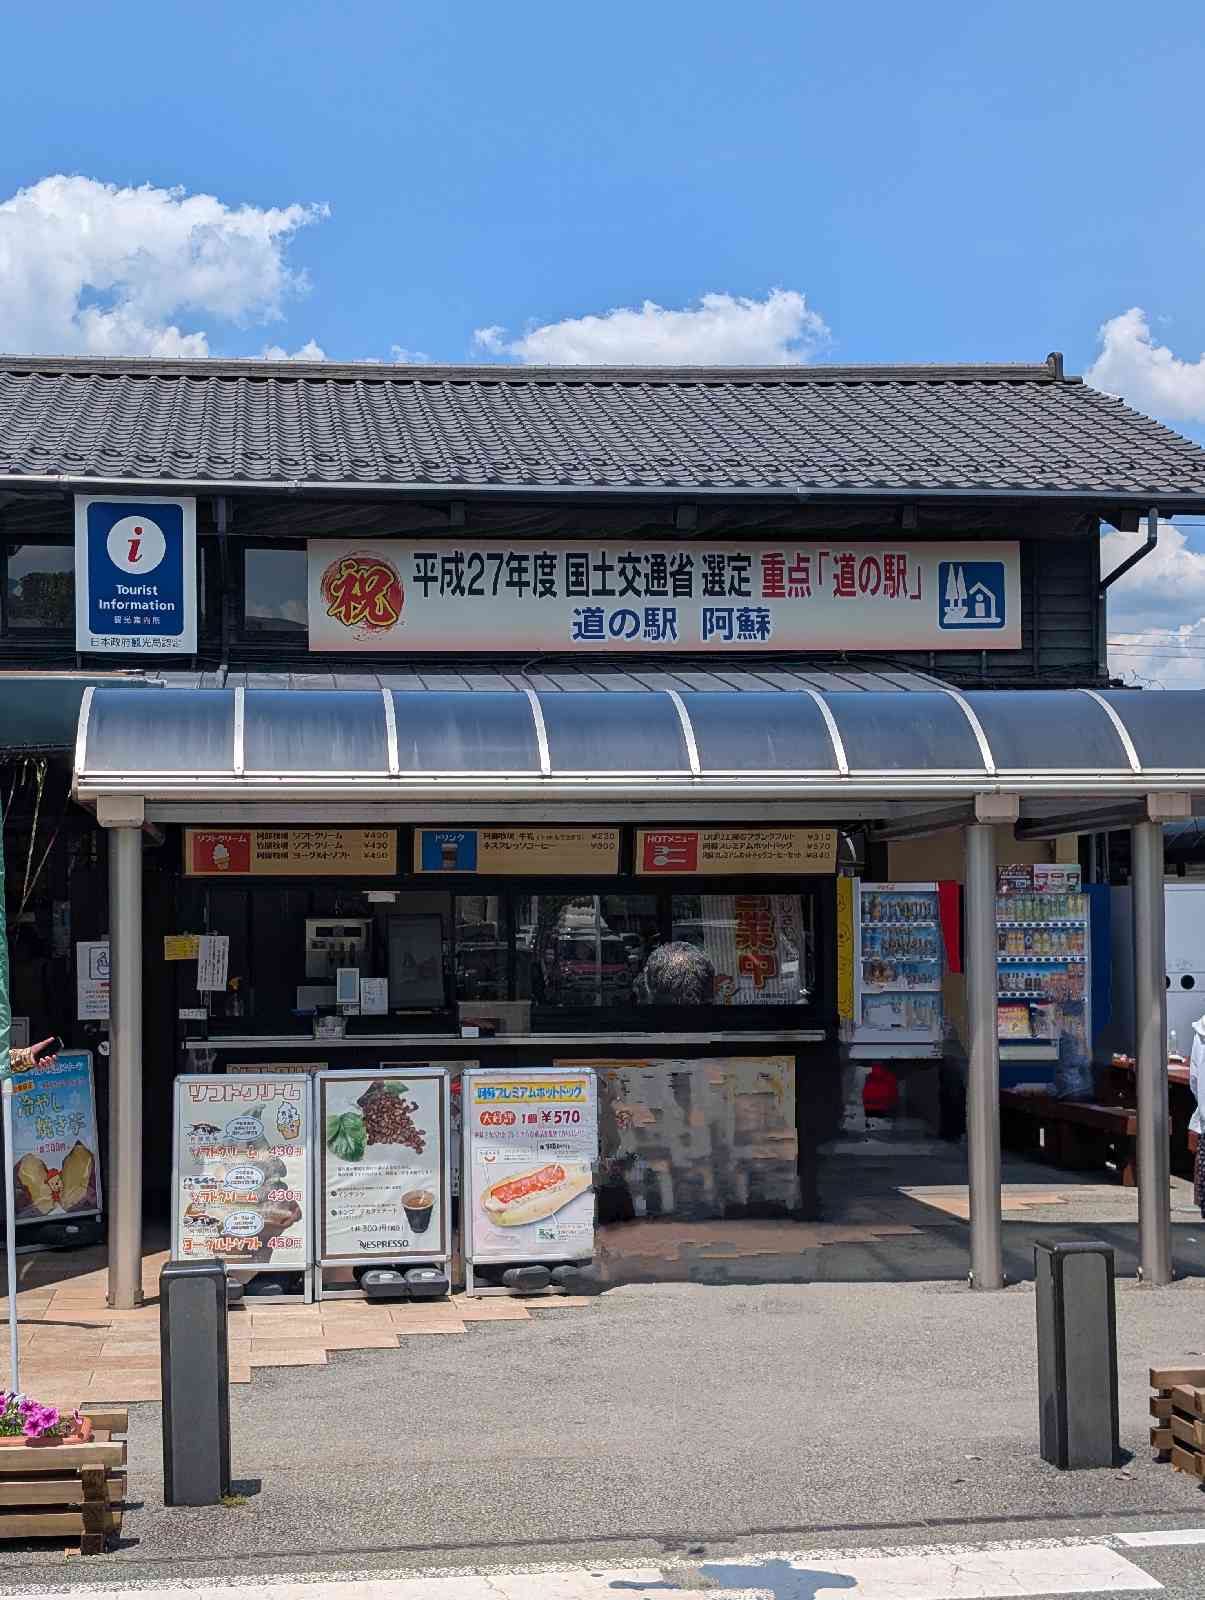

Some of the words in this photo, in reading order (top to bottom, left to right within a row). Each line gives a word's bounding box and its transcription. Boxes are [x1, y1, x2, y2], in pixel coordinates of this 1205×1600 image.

[412, 551, 558, 598] 平成27年度
[565, 551, 694, 598] 国土交通省
[702, 552, 752, 599] 選定
[761, 552, 922, 600] 重点「道の駅」
[116, 584, 159, 596] Tourist
[98, 598, 176, 611] Information
[571, 606, 679, 642] 道の駅
[702, 606, 771, 642] 阿蘇
[189, 1081, 301, 1103] ソフトクリーム
[541, 1110, 580, 1124] ¥570
[359, 1239, 409, 1251] NESPRESSO
